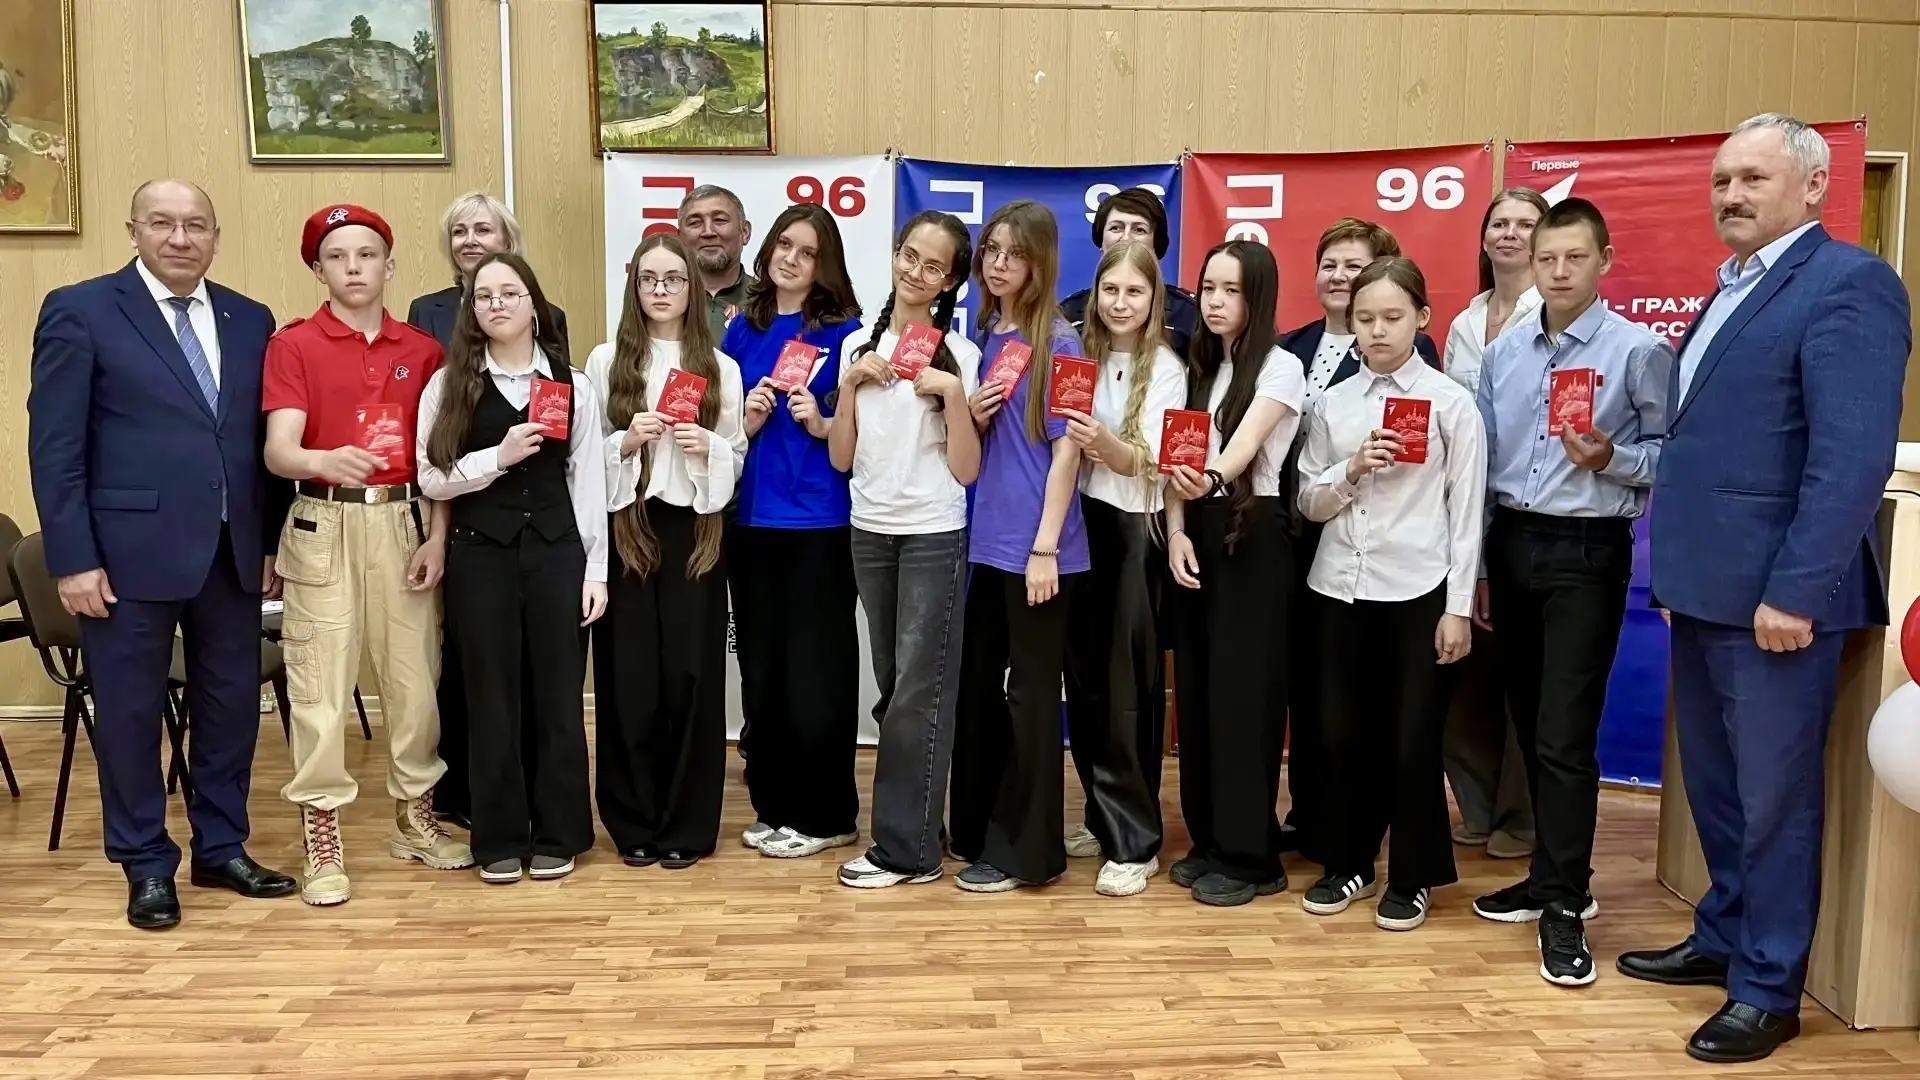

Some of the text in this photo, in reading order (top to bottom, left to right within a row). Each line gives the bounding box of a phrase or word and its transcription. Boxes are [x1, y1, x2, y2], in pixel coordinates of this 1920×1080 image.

[1531, 160, 1580, 172] Первые
[786, 175, 866, 217] 96
[1376, 166, 1465, 212] 96
